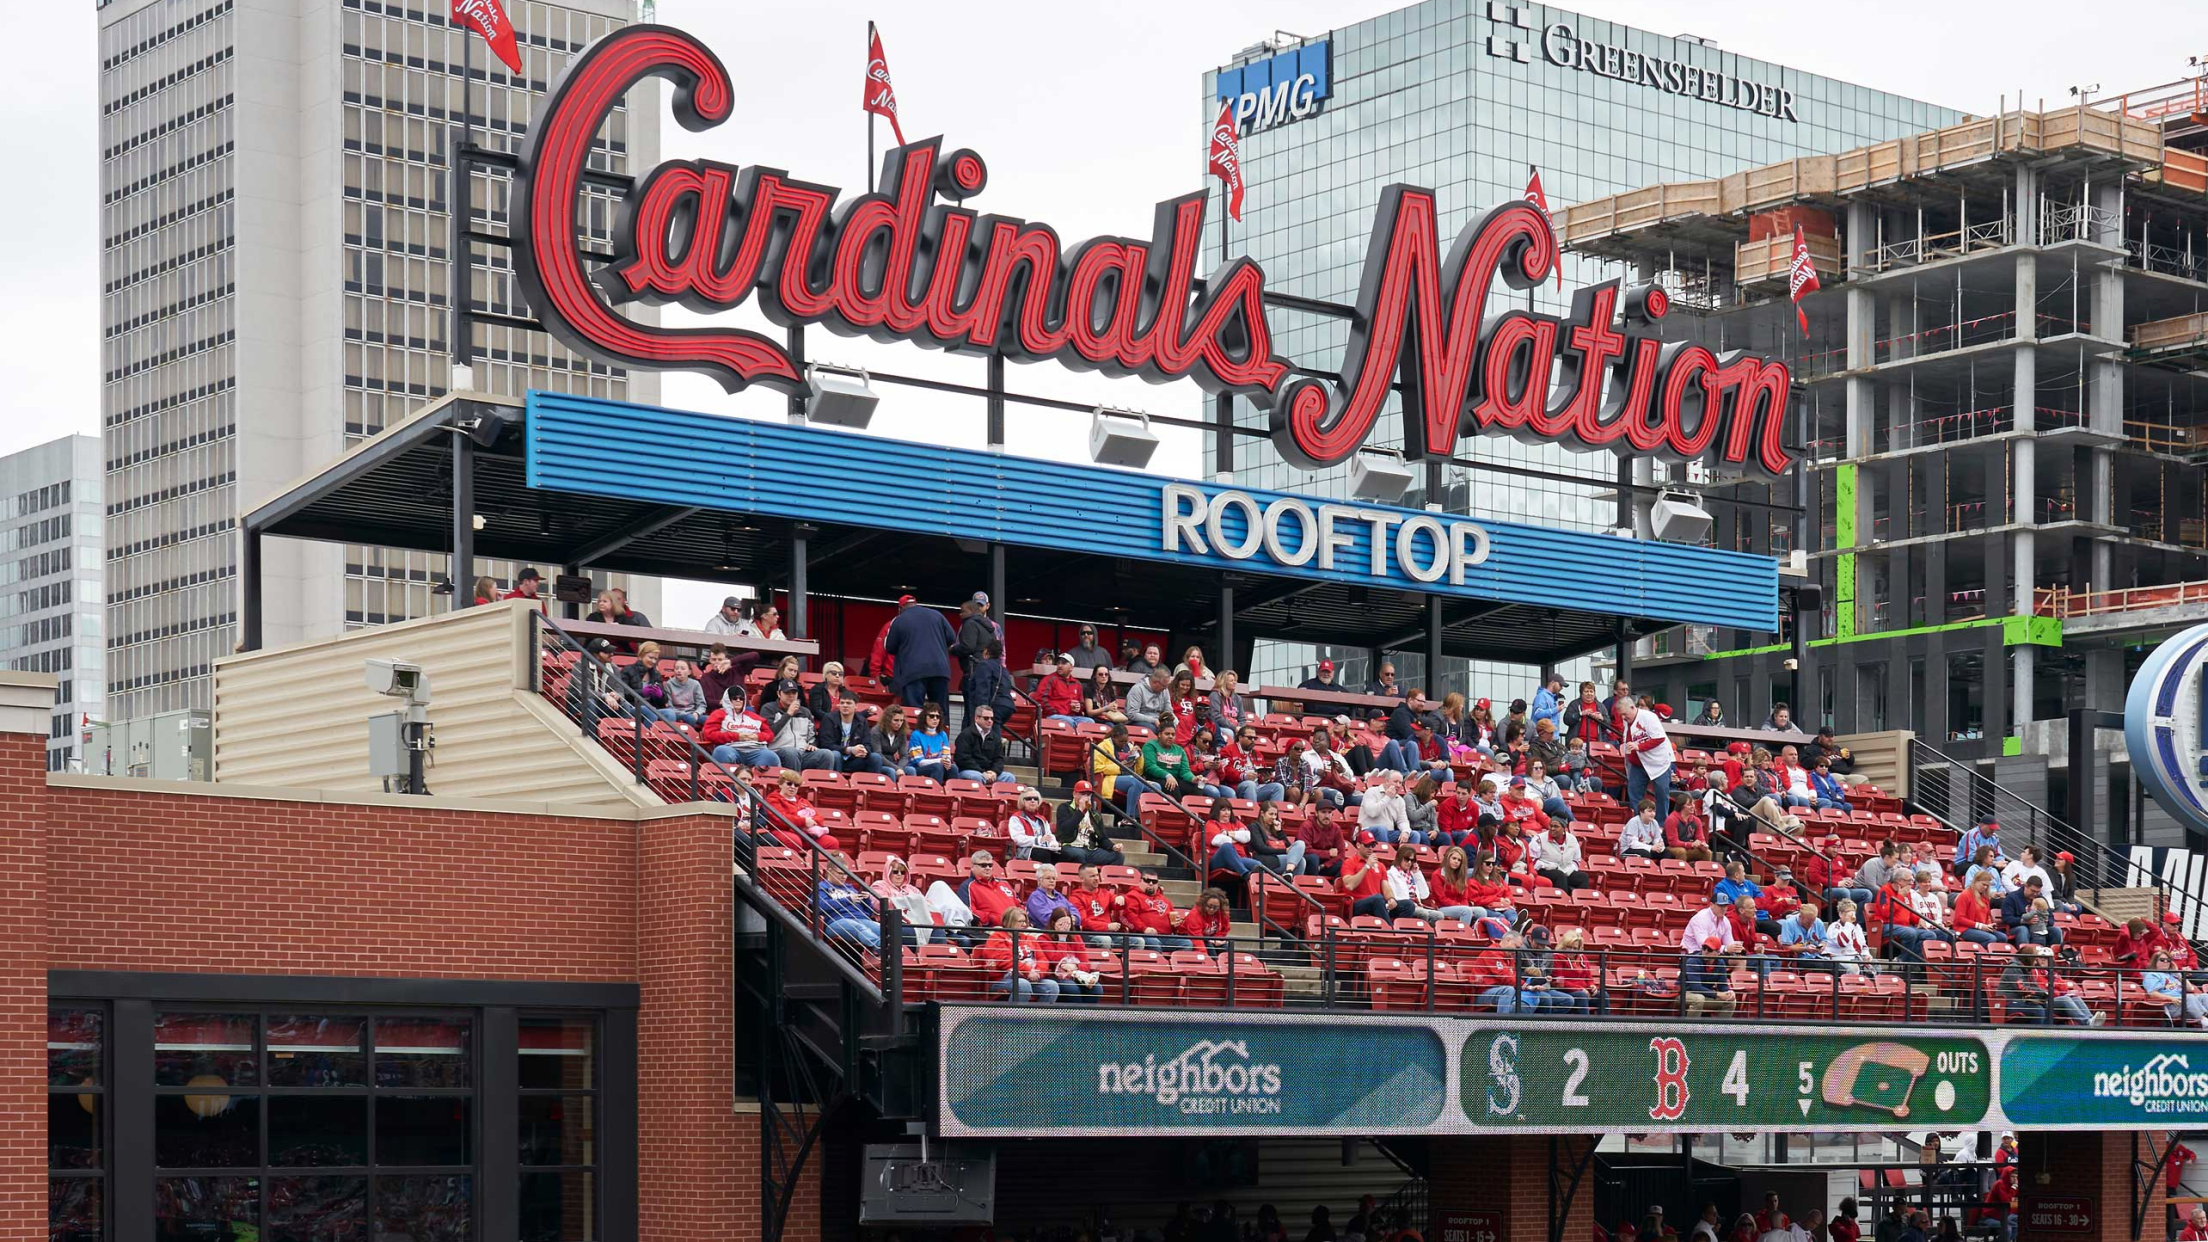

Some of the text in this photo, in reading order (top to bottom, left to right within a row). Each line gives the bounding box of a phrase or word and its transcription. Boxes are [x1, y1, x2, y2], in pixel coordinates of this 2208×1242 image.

[866, 59, 892, 86] Car
[1542, 23, 1798, 122] GREENSFELDER
[1211, 148, 1239, 190] Nation
[513, 24, 1798, 482] Cardinals Nation
[1162, 483, 1490, 585] ROOFTOP
[1099, 1040, 1281, 1105] neighbors
[1562, 1048, 1589, 1106] 2
[1650, 1037, 1749, 1120] B 4
[1797, 1062, 1814, 1094] 5
[1936, 1052, 1978, 1073] OUTS
[2094, 1053, 2208, 1106] neighbors
[1180, 1097, 1281, 1114] CREDIT UNION
[2144, 1100, 2174, 1113] CREDIT
[1444, 1229, 1464, 1242] SEATS
[1448, 1217, 1483, 1225] ROOFTOP
[2031, 1213, 2052, 1225] SEATS
[2054, 1214, 2062, 1225] 16
